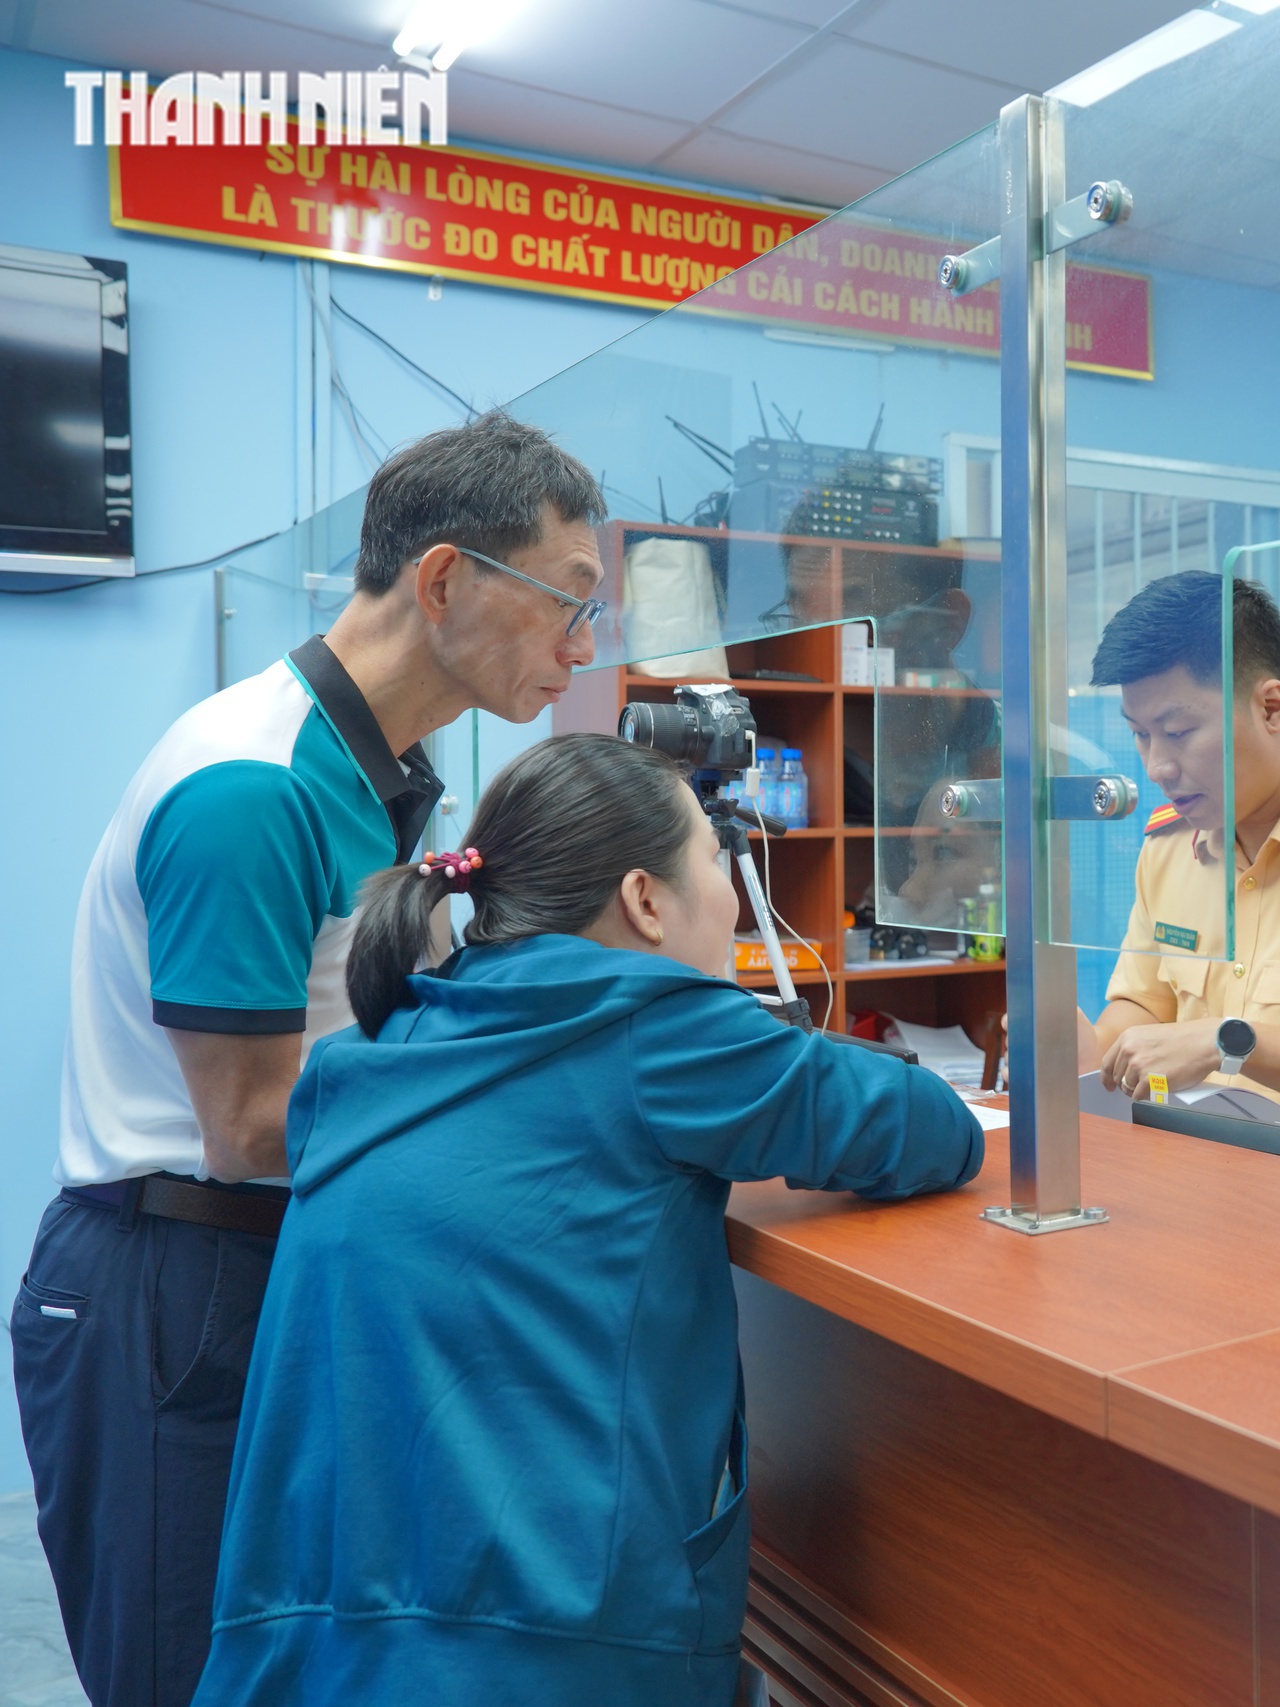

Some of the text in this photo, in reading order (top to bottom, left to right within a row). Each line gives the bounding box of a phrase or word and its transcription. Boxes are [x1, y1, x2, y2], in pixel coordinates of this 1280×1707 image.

[222, 183, 995, 337] LÀ THƯỚC ĐO CHẤT LƯỢNG CẢI CÁCH HÀNH
[265, 143, 330, 187] SỰ
[340, 150, 412, 195] HÀI
[425, 165, 530, 215] LÒNG
[543, 184, 620, 231] CỦA
[631, 203, 741, 251] NGƯỜI
[753, 224, 829, 267] DÂN,
